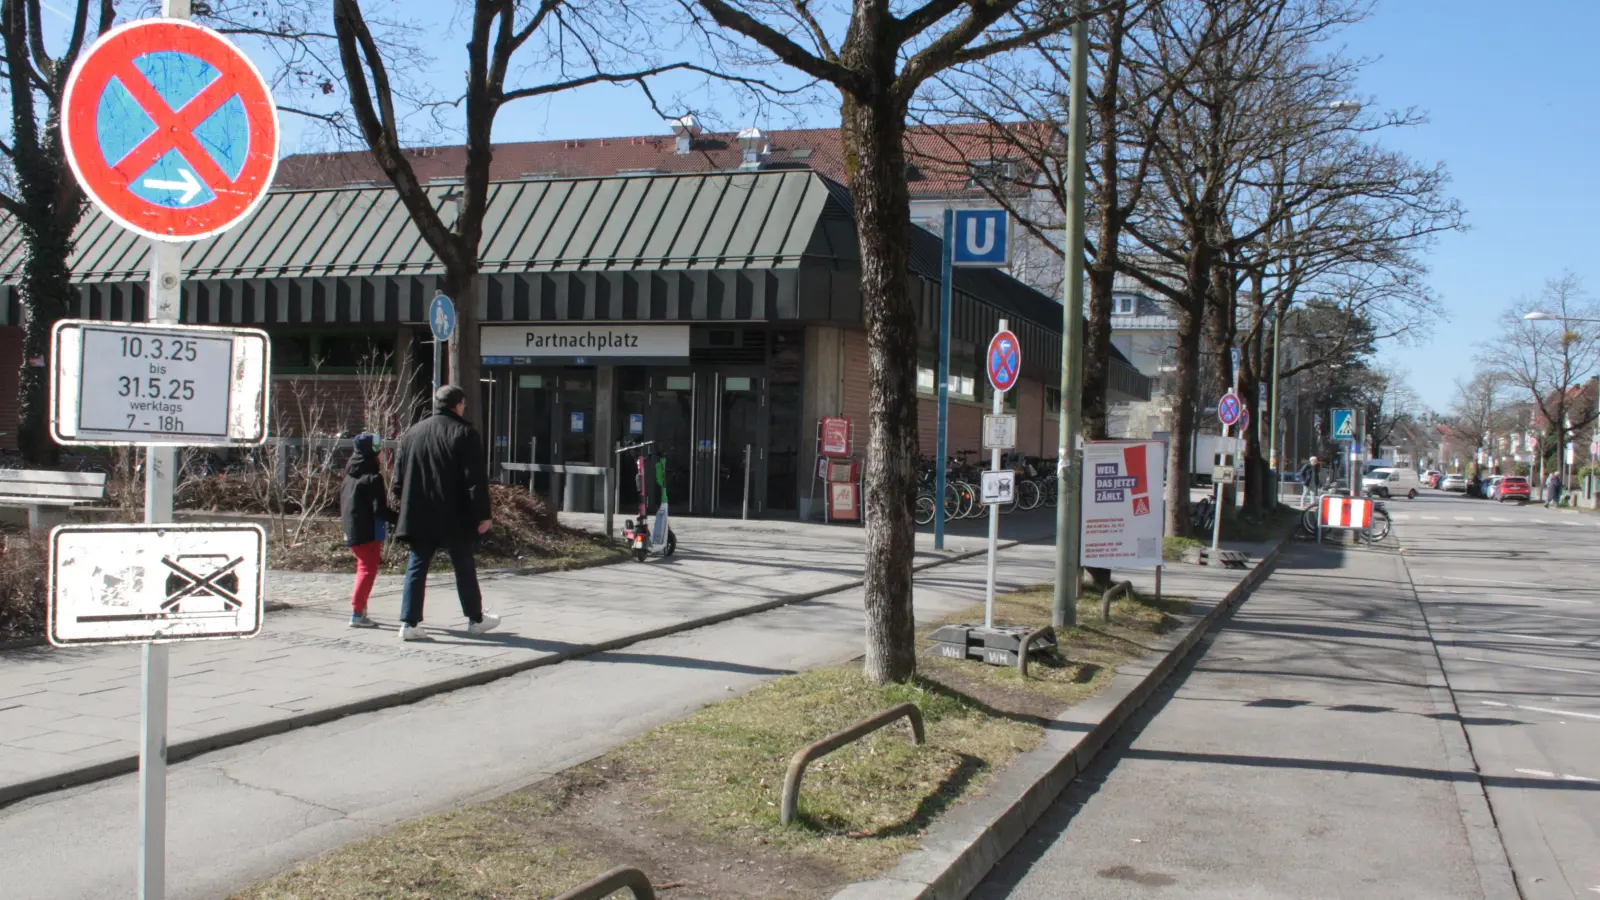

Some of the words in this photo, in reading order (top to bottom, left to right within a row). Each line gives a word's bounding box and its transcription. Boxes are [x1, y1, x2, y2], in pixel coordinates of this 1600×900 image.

[966, 217, 996, 256] U
[525, 331, 639, 351] Partnachplatz
[121, 336, 198, 362] 10.3.25
[149, 363, 167, 375] bis
[118, 375, 195, 401] 31.5.25
[129, 401, 183, 415] werktags
[126, 414, 136, 430] 7
[158, 415, 184, 431] 18h
[1097, 465, 1116, 474] WEIL
[1097, 479, 1113, 488] DAS
[1113, 478, 1136, 489] JETZT
[1097, 491, 1122, 501] ZÄHLT.
[942, 646, 960, 658] WH
[988, 652, 1008, 664] WH
